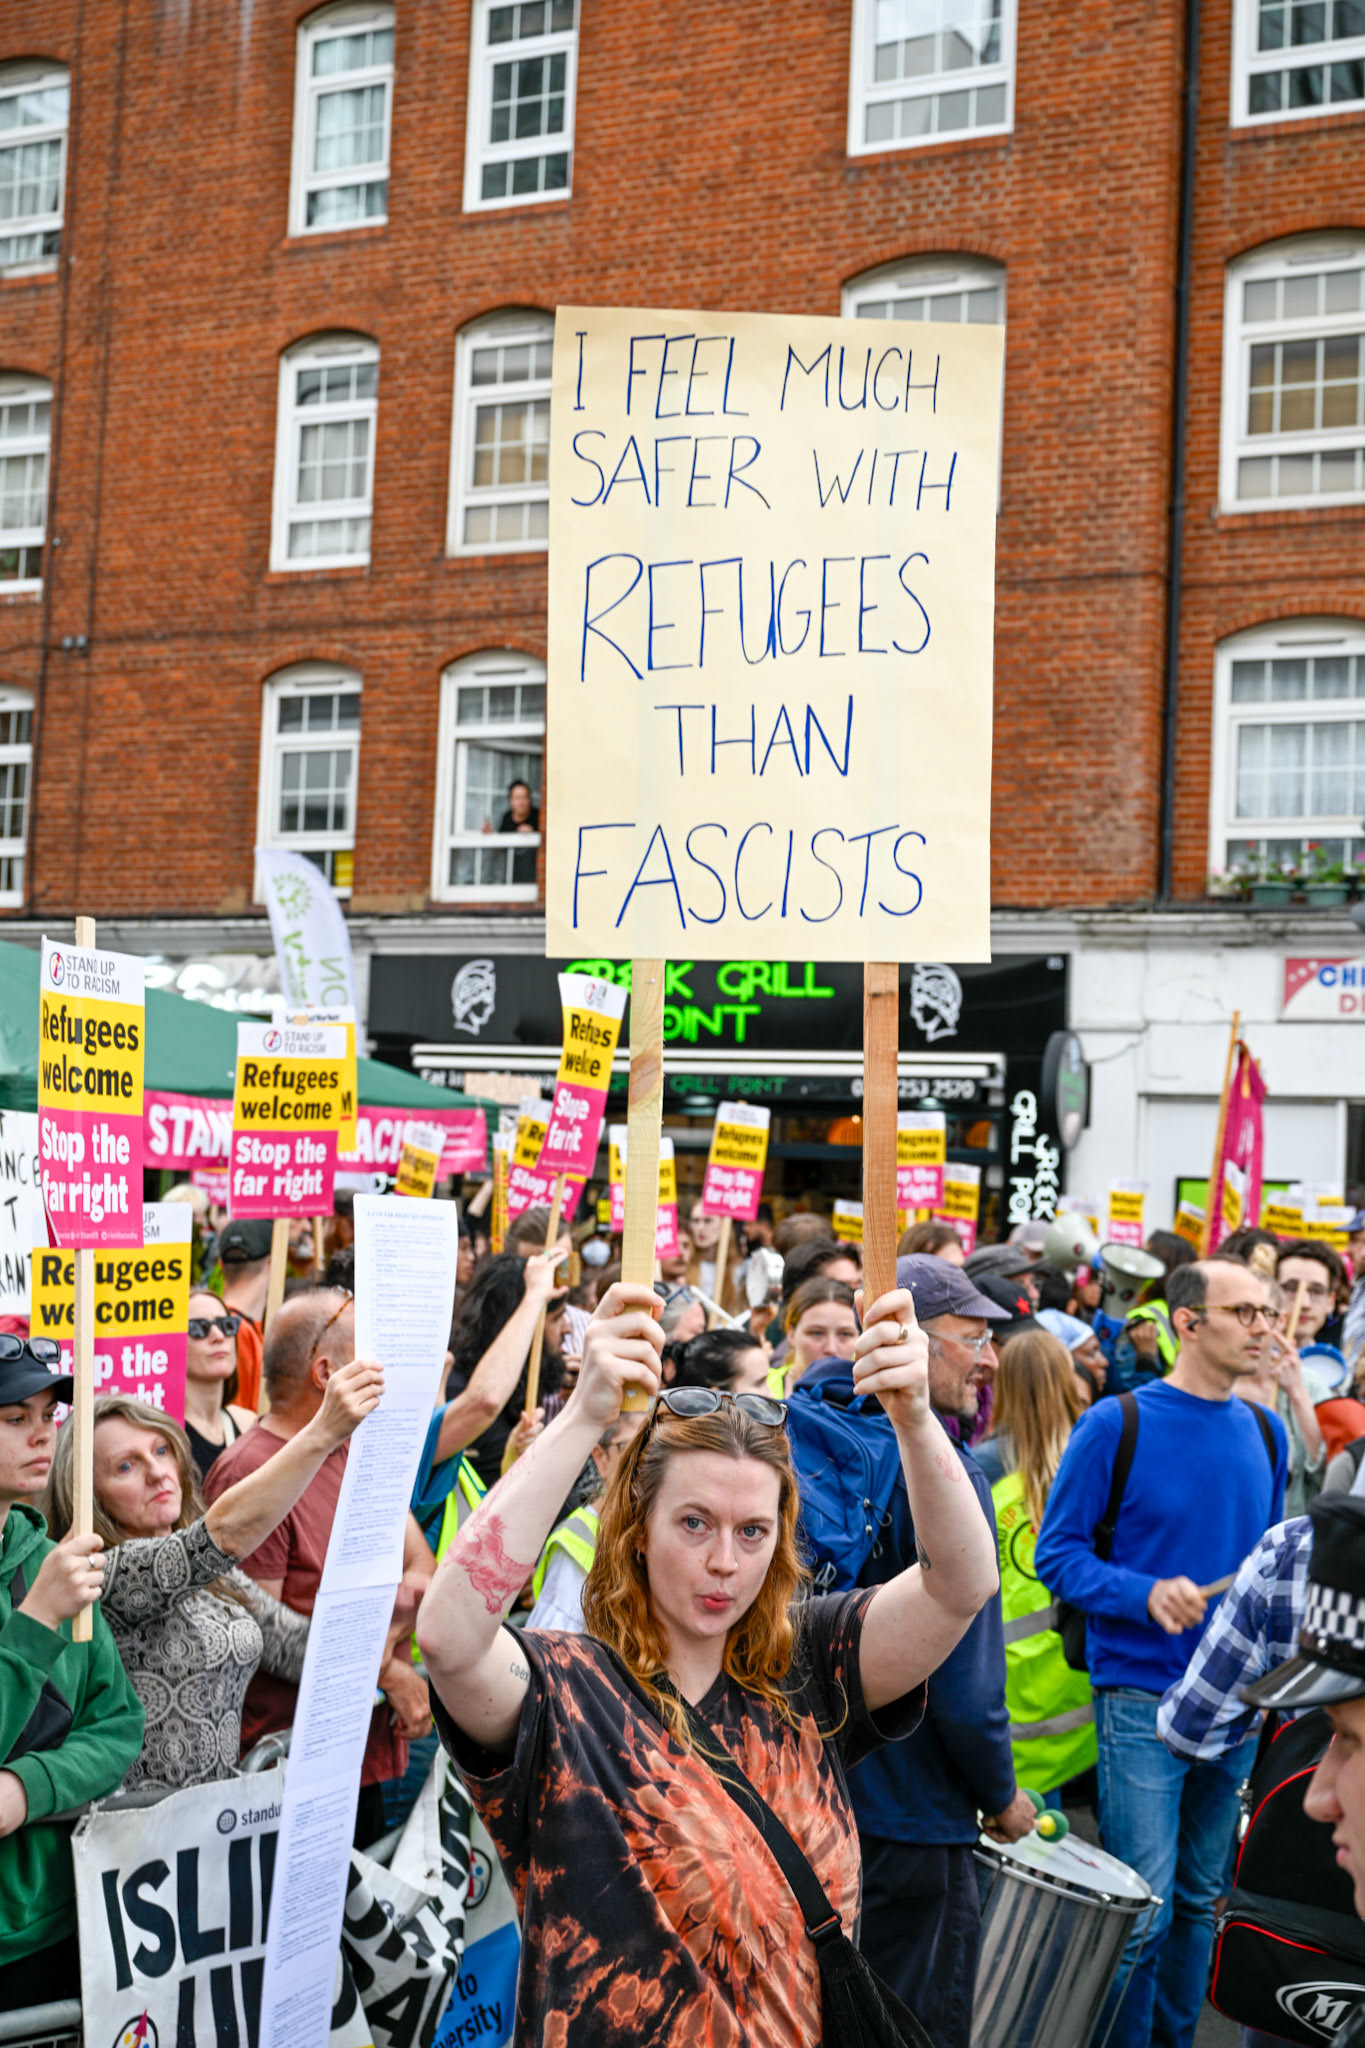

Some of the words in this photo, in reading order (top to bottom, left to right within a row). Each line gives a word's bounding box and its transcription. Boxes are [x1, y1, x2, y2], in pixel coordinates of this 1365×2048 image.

[573, 331, 587, 410] I
[626, 334, 750, 419] FEEL
[781, 344, 940, 413] MUCH
[571, 430, 771, 509] SAFER
[813, 448, 958, 511] WITH
[580, 552, 932, 682] REFUGEES
[654, 694, 854, 777] THAN
[572, 822, 927, 930] FASCISTS
[66, 955, 97, 974] STAND
[100, 960, 115, 976] UP
[565, 959, 694, 999] REK
[717, 960, 836, 1003] GRILL
[67, 973, 80, 989] TO
[84, 977, 120, 996] RACISM
[42, 999, 139, 1056] Refugees
[663, 1003, 762, 1043] OINT
[285, 1043, 296, 1053] TO
[42, 1054, 133, 1098] welcome
[243, 1063, 339, 1096] Refugees
[898, 1078, 930, 1098] 253
[931, 1078, 976, 1099] 2570
[241, 1095, 332, 1120] welcome
[41, 1117, 86, 1173] Stop
[91, 1123, 130, 1165] the
[148, 1103, 235, 1158] STAN
[236, 1136, 291, 1171] Stop
[295, 1137, 327, 1165] the
[42, 1169, 67, 1212] far
[68, 1171, 129, 1224] right
[233, 1168, 268, 1197] far
[273, 1168, 324, 1203] right
[510, 1168, 548, 1196] Stop
[41, 1255, 183, 1292] Reugees
[40, 1297, 175, 1327] wecome
[121, 1344, 169, 1378] the
[999, 1508, 1017, 1529] UP
